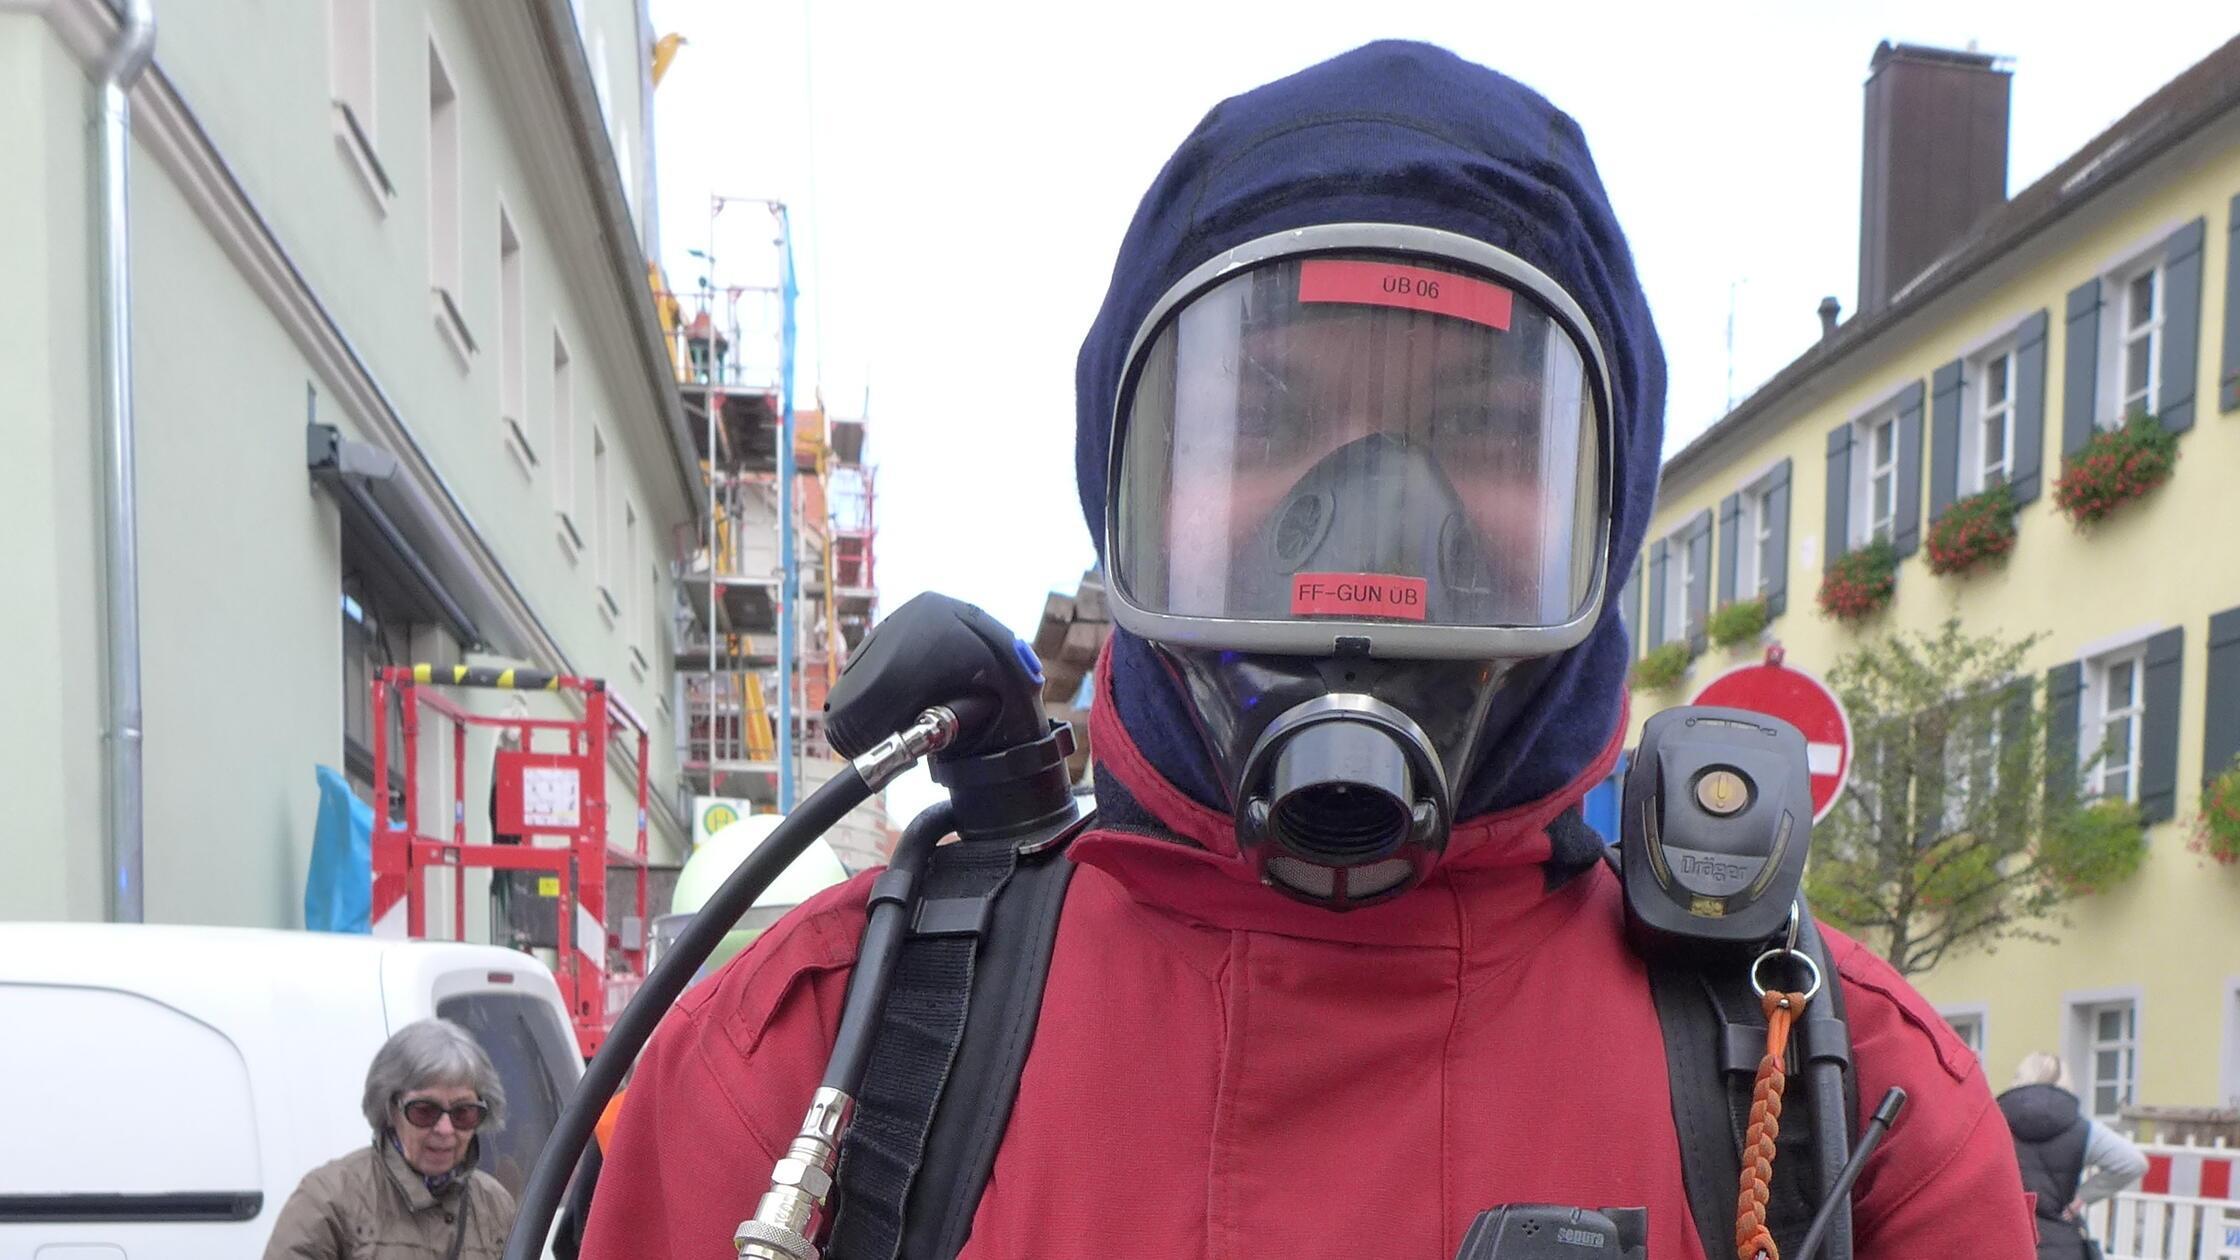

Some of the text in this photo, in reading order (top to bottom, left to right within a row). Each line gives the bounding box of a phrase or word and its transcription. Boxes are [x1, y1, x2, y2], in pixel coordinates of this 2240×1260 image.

[1383, 275, 1440, 299] ÜB 06
[1299, 583, 1418, 605] FF-GUN ÜB
[1681, 855, 1746, 881] Dräger
